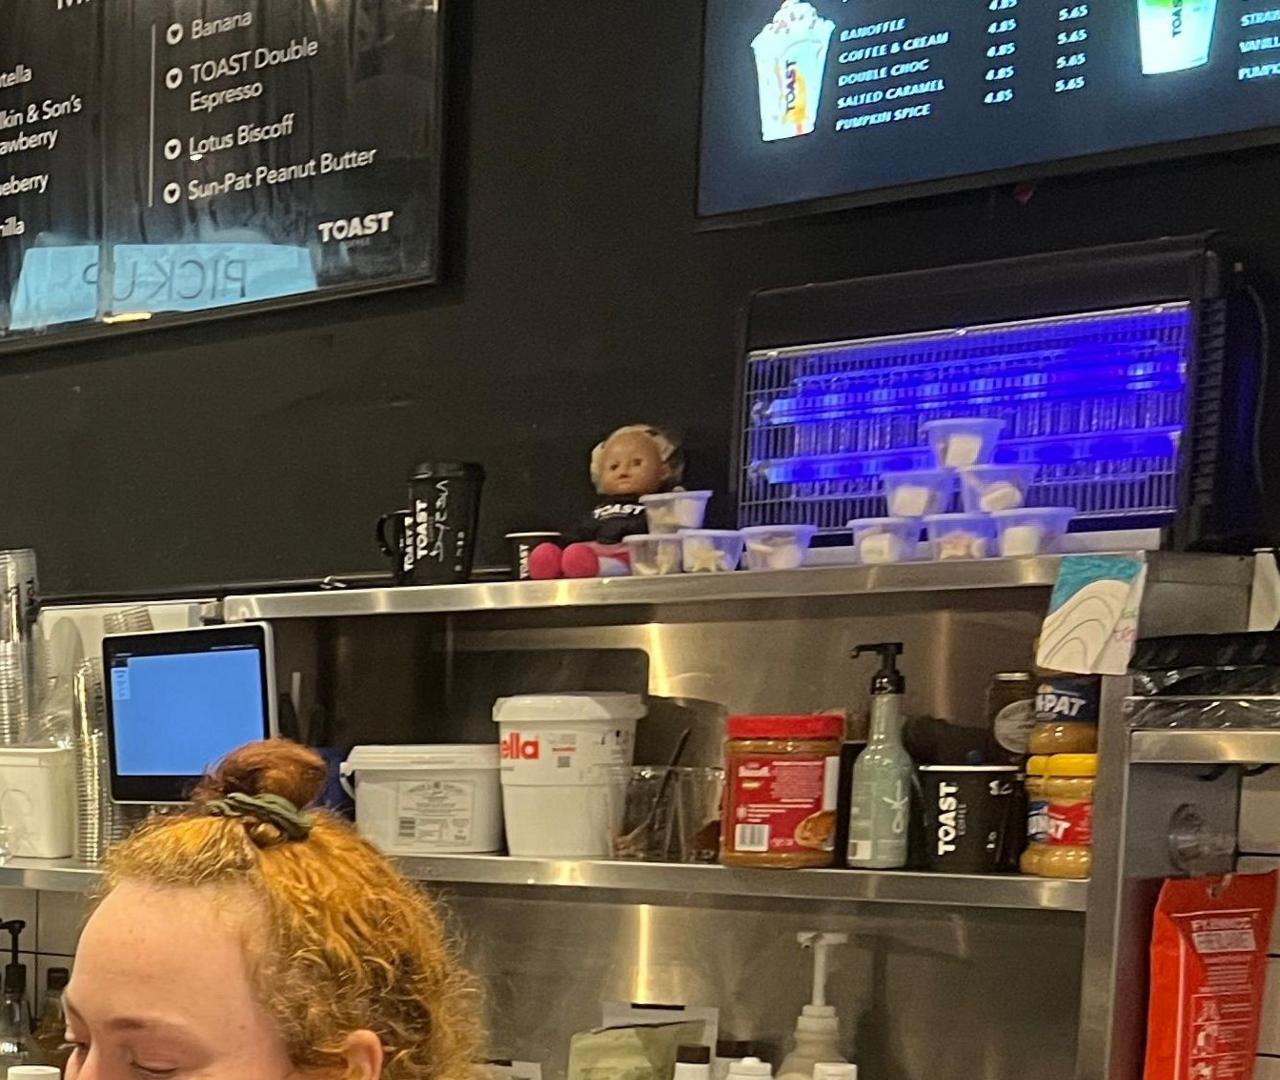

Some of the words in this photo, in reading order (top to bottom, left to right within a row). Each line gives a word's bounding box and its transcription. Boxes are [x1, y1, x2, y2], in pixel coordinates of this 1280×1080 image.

[191, 11, 252, 40] Banana
[190, 50, 252, 84] TOAST
[254, 37, 319, 70] Double
[26, 103, 40, 124] &
[42, 94, 82, 120] Son's
[190, 82, 263, 112] Espresso
[893, 103, 931, 121] SPICE
[189, 133, 234, 156] Lotus
[237, 113, 295, 145] Biscoff
[188, 172, 252, 200] Sun-Pat
[255, 159, 317, 187] Peanut
[320, 149, 377, 175] Butter
[318, 210, 394, 242] TOAST
[415, 499, 429, 559] TOAST
[937, 782, 959, 856] TOAST
